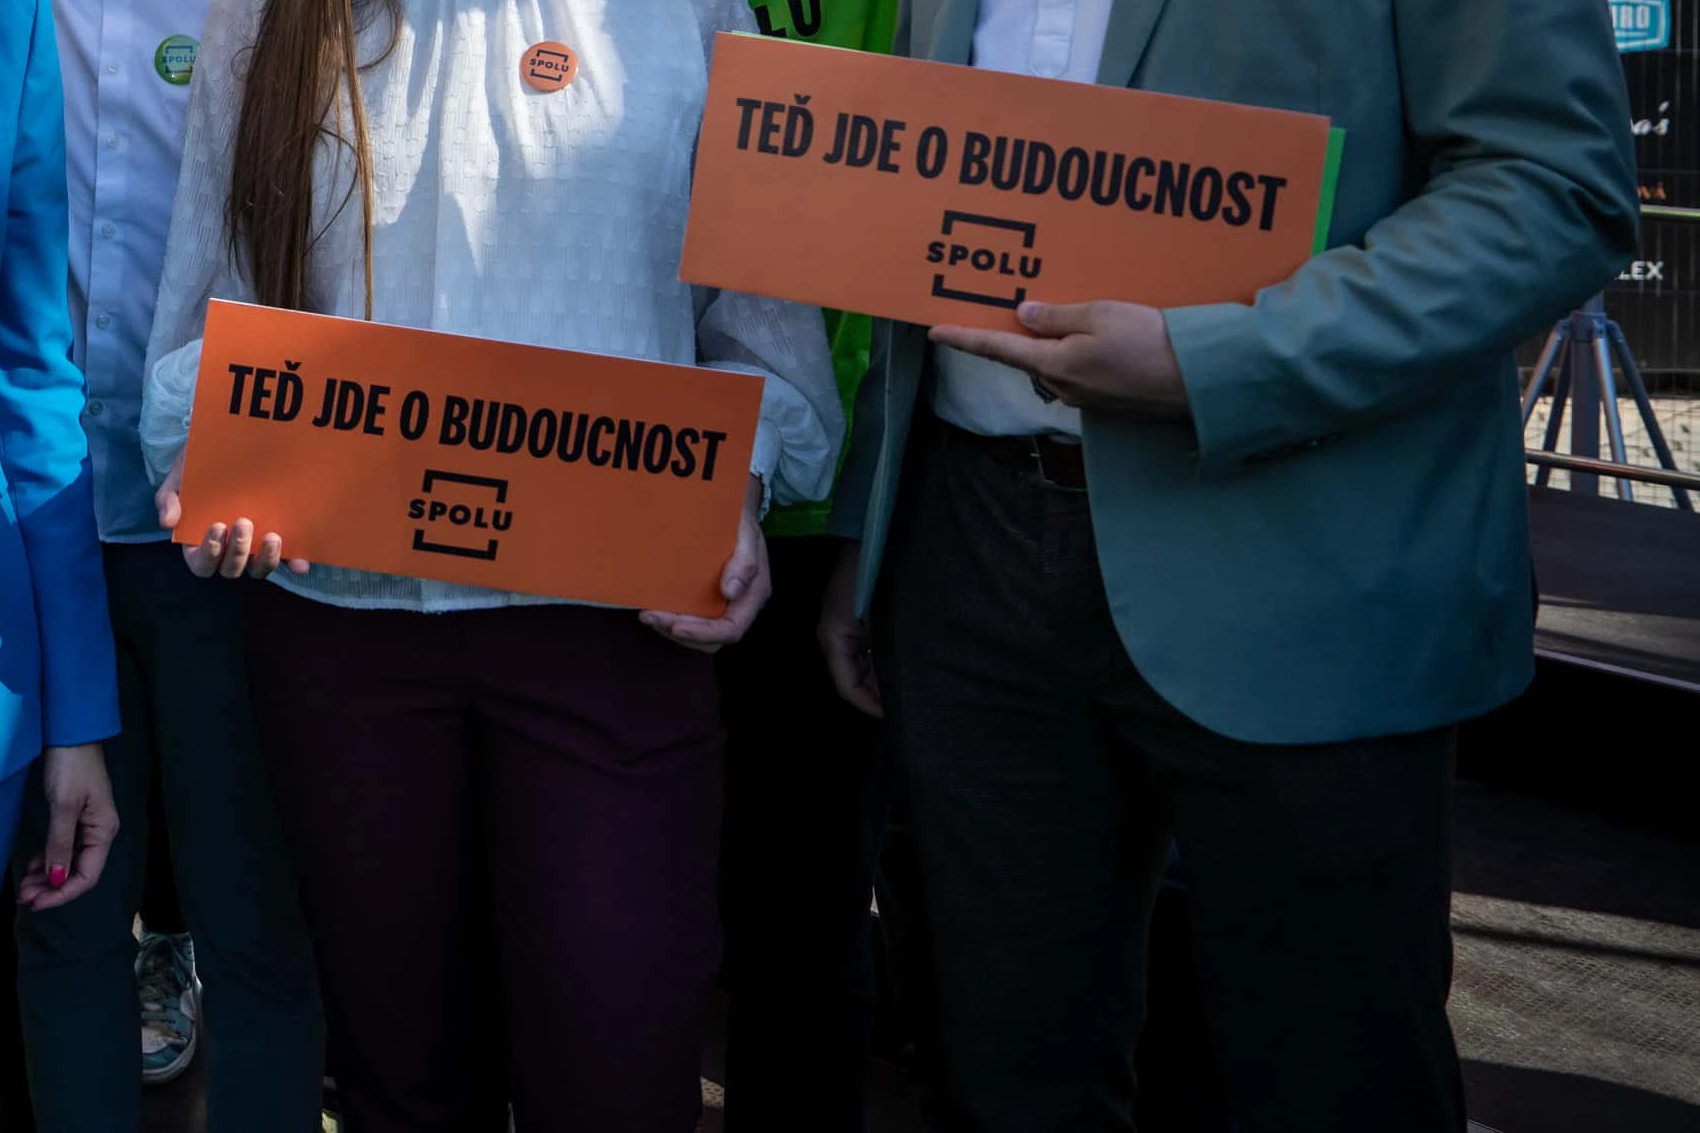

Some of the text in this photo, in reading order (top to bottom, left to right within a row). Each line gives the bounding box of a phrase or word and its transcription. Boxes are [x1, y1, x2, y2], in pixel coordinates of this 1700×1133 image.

[530, 58, 569, 72] SPOLU
[737, 95, 1287, 231] TEĎ JDE O BUDOUCNOST
[927, 242, 1041, 278] SPOLU
[229, 361, 727, 481] TEĎ JDE O BUDOUCNOST
[408, 499, 512, 531] SPOLU
